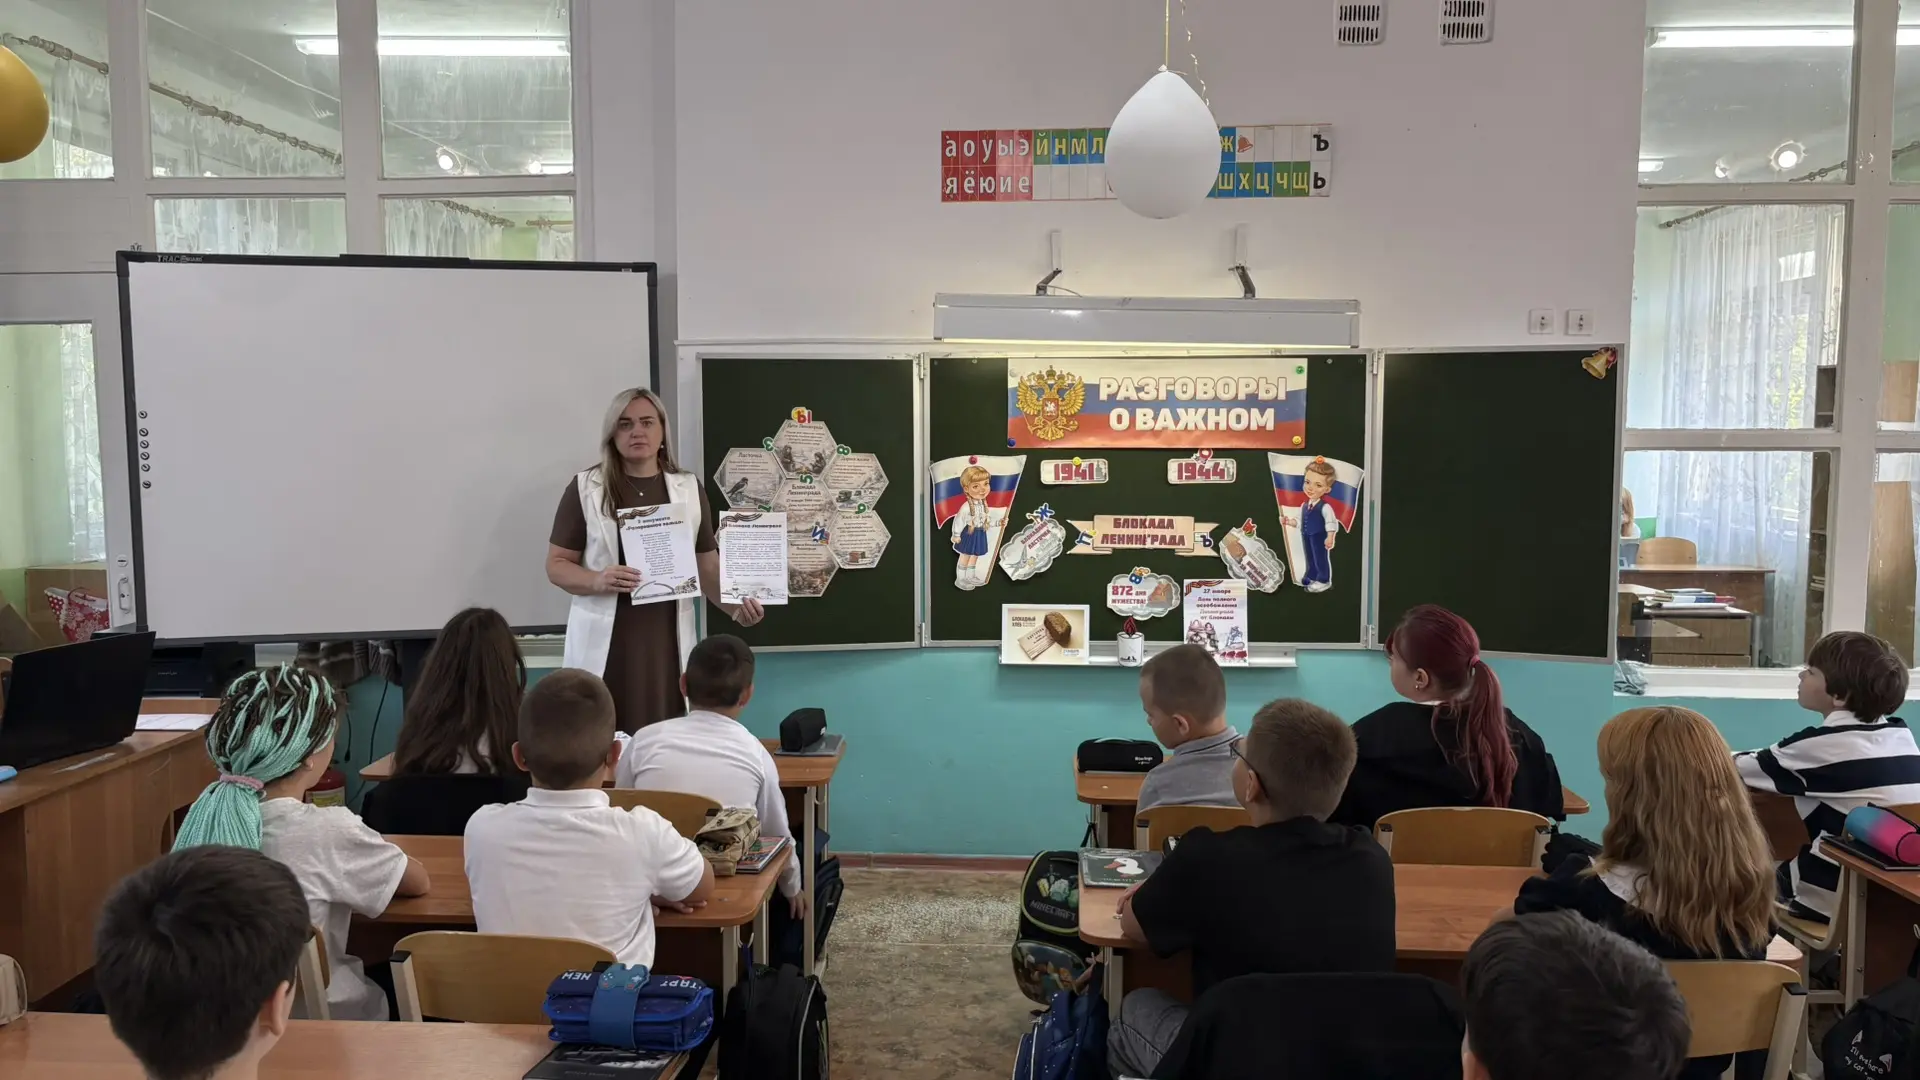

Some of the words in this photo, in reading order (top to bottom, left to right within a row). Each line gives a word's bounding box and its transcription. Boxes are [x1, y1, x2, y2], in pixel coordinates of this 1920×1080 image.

[1098, 376, 1288, 401] РАЗГОВОРЫ
[1108, 407, 1130, 432] О
[1135, 407, 1276, 432] ВАЖНОМ
[1053, 462, 1095, 481] 1941
[1177, 462, 1226, 480] 1944
[1113, 517, 1175, 530] БЛОКАДА
[1111, 585, 1134, 596] 872
